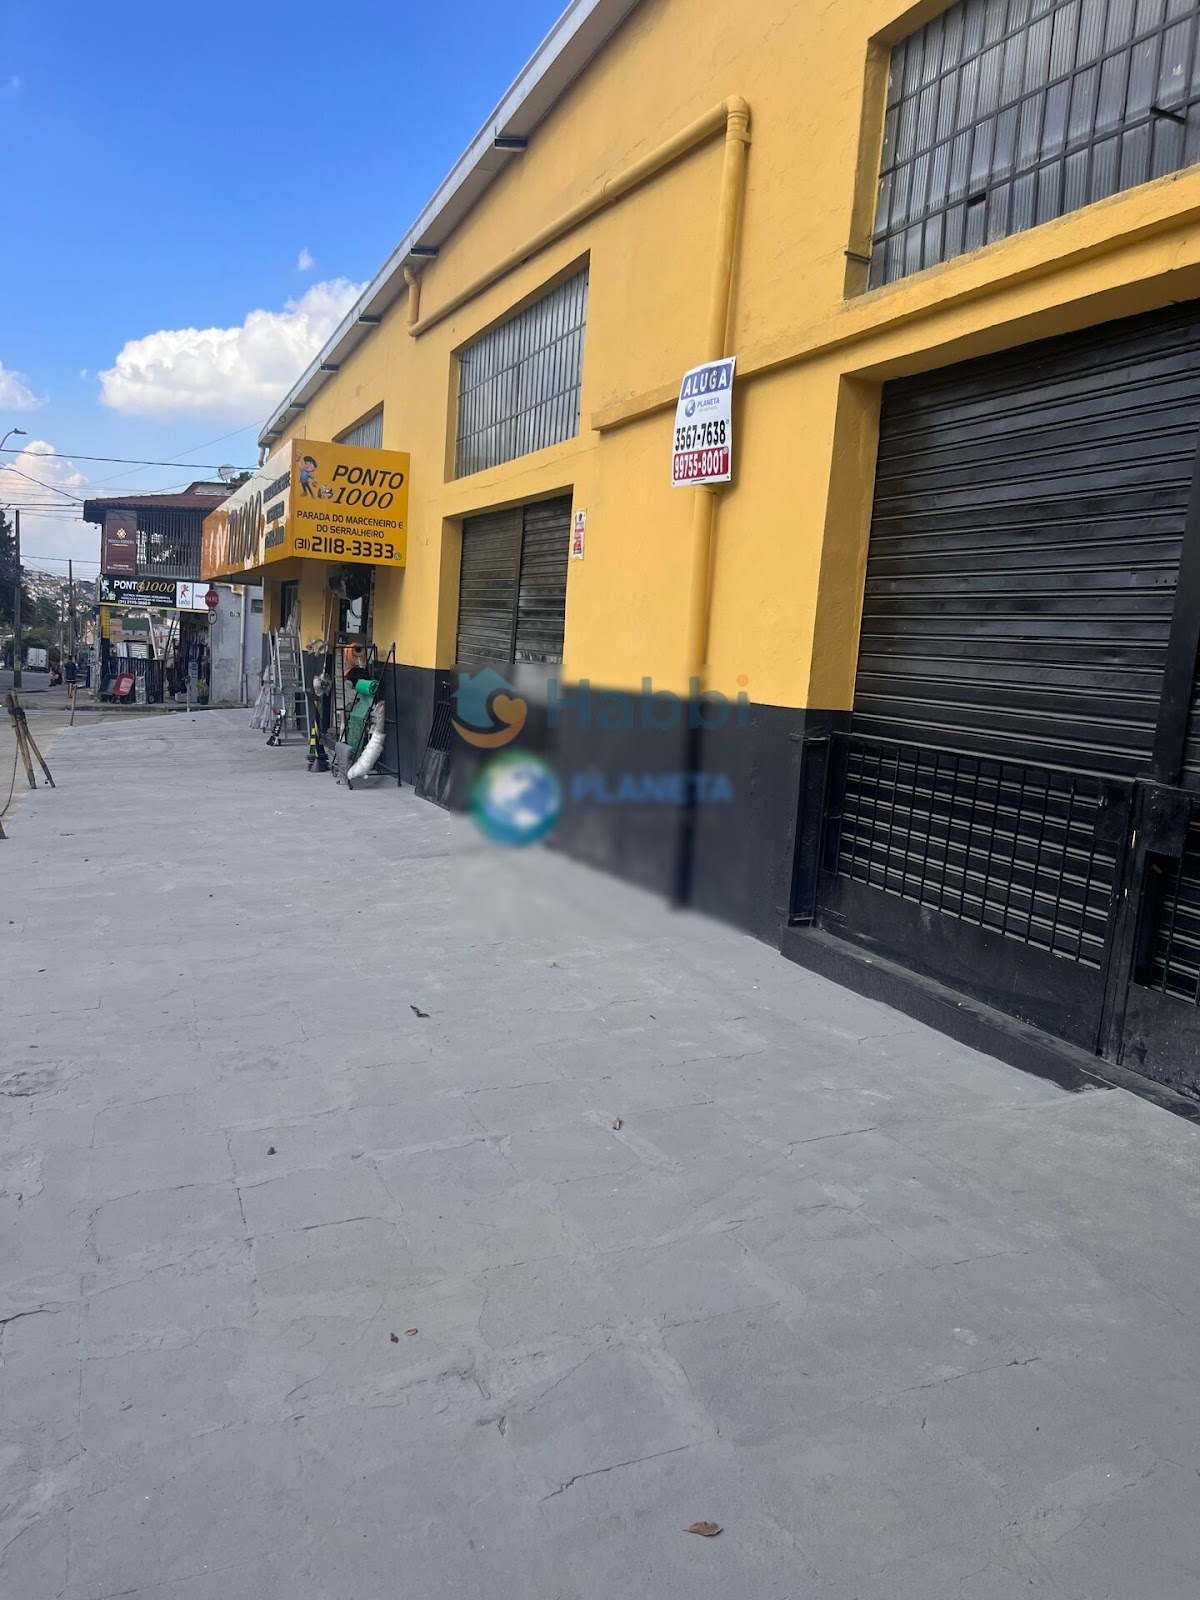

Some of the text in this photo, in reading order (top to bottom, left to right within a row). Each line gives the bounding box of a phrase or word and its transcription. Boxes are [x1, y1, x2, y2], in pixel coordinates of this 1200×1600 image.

[683, 367, 727, 397] ALUGA
[696, 397, 720, 408] PLANETA
[675, 420, 726, 451] 3567-7638
[674, 449, 724, 479] 99755-8001
[332, 465, 405, 490] PONTO
[333, 487, 394, 509] 1000
[297, 510, 331, 522] PARADA
[332, 514, 344, 523] DO
[345, 516, 397, 529] MARCENEIRO
[397, 521, 404, 529] E
[316, 524, 385, 538] DO SERRALHEIRO
[311, 536, 394, 560] 2118-3333
